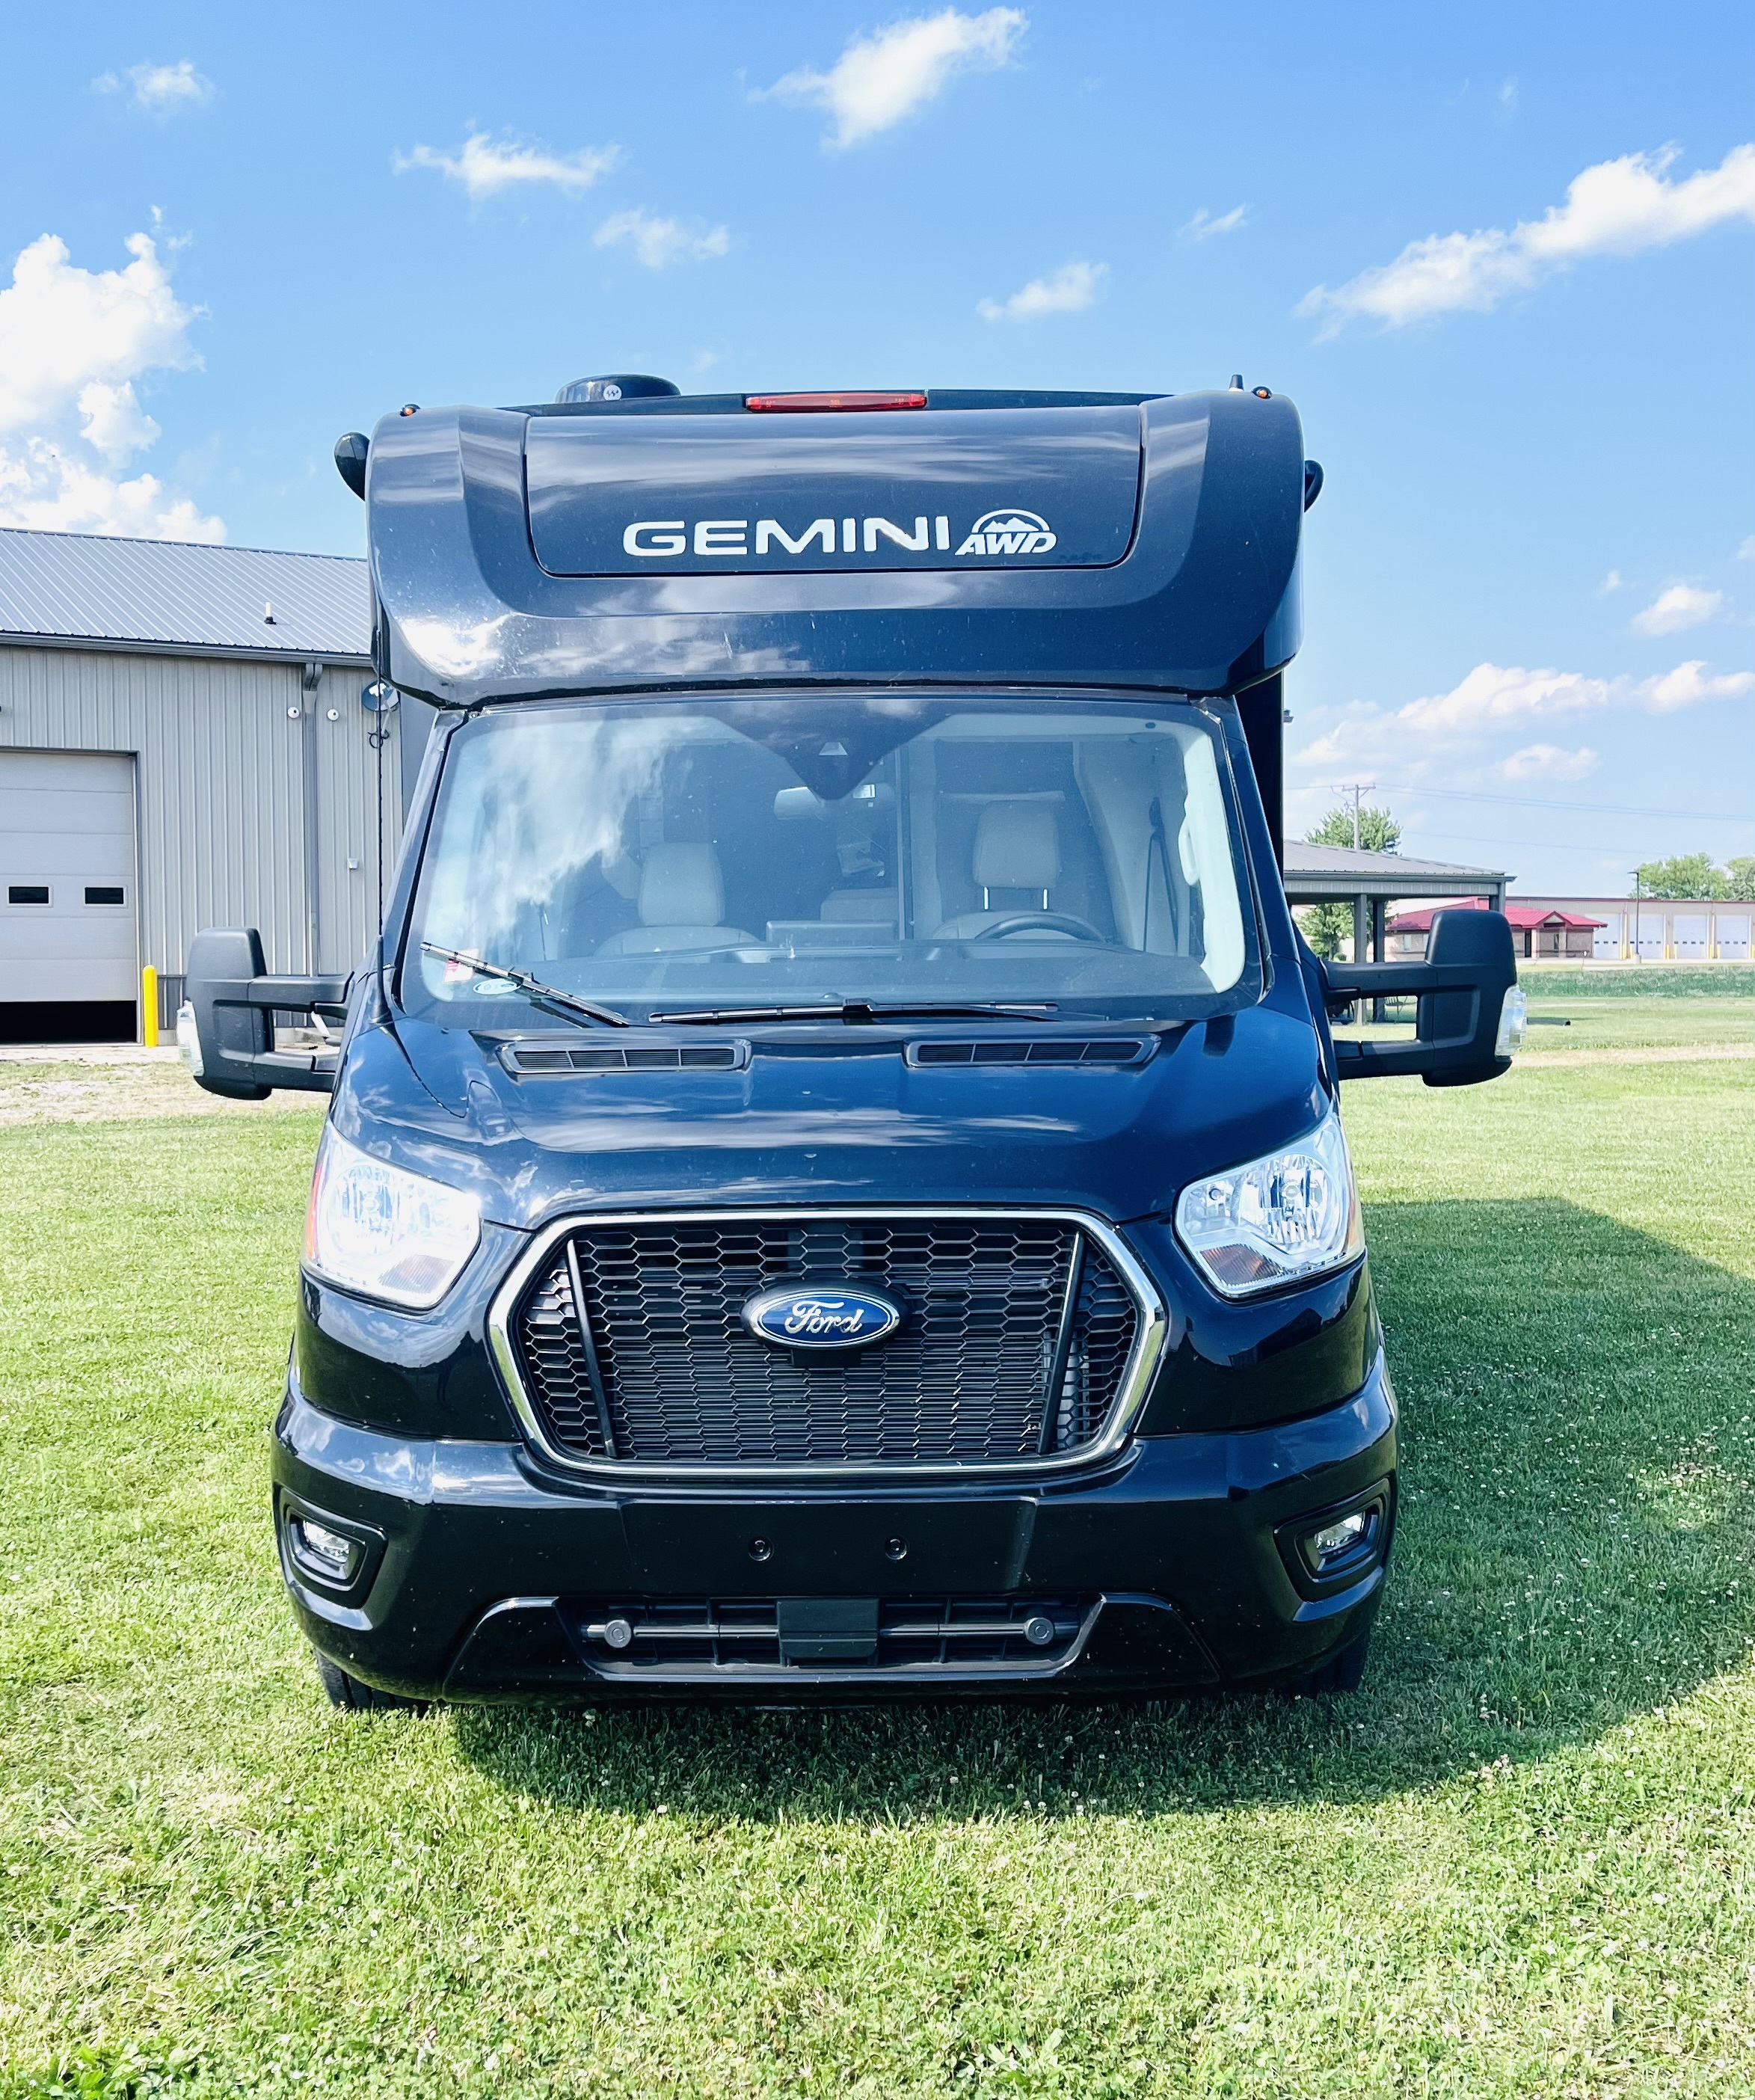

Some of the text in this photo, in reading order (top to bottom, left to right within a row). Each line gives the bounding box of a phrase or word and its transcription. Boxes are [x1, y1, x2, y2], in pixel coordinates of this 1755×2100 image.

[623, 516, 1057, 556] GEMINI AWD
[784, 1300, 864, 1334] Ford
